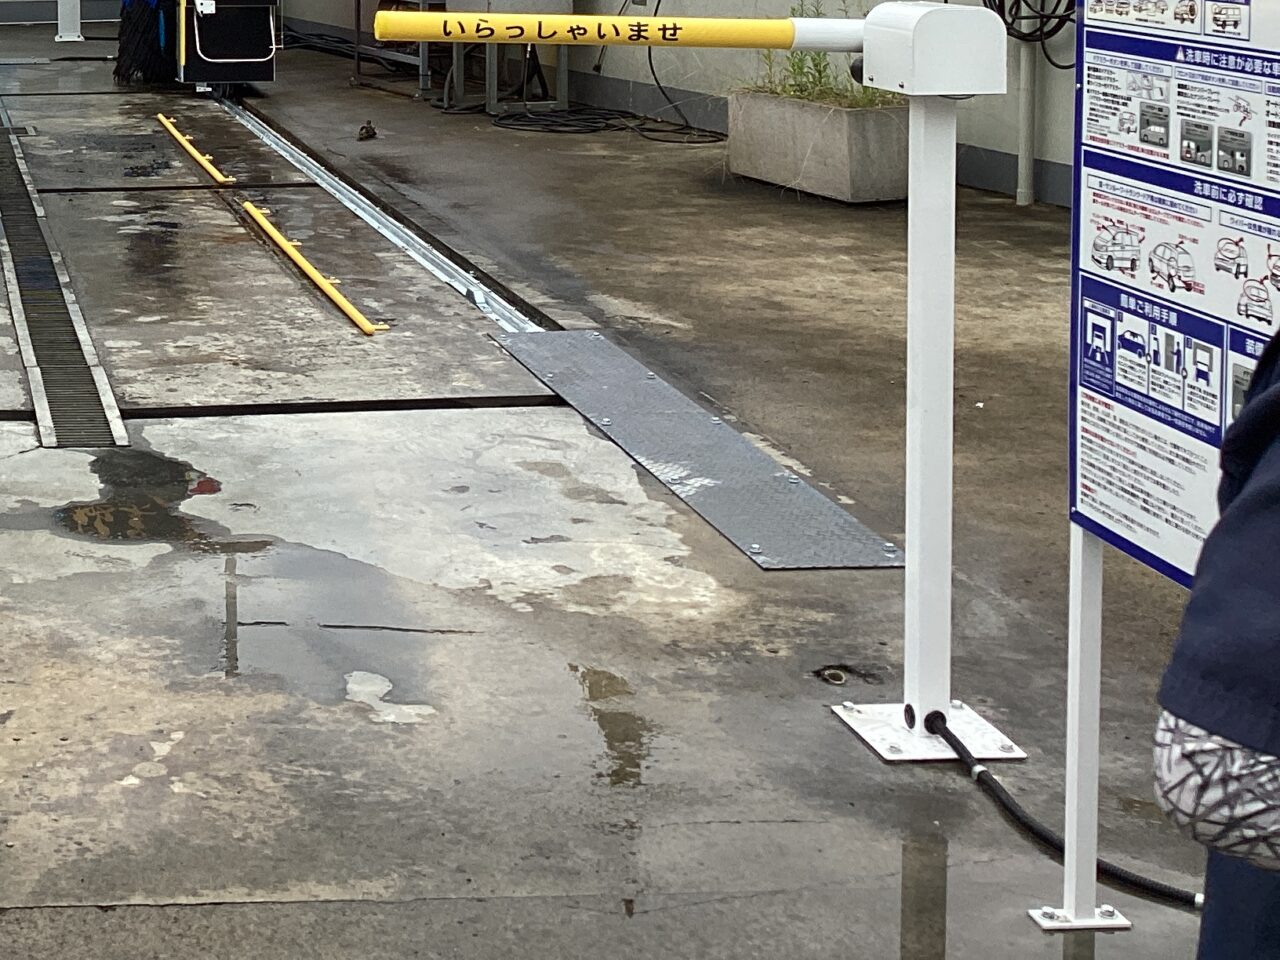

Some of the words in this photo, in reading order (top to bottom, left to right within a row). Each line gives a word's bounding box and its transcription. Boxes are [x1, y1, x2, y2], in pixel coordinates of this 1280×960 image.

[442, 18, 683, 41] いらっしゃいませ
